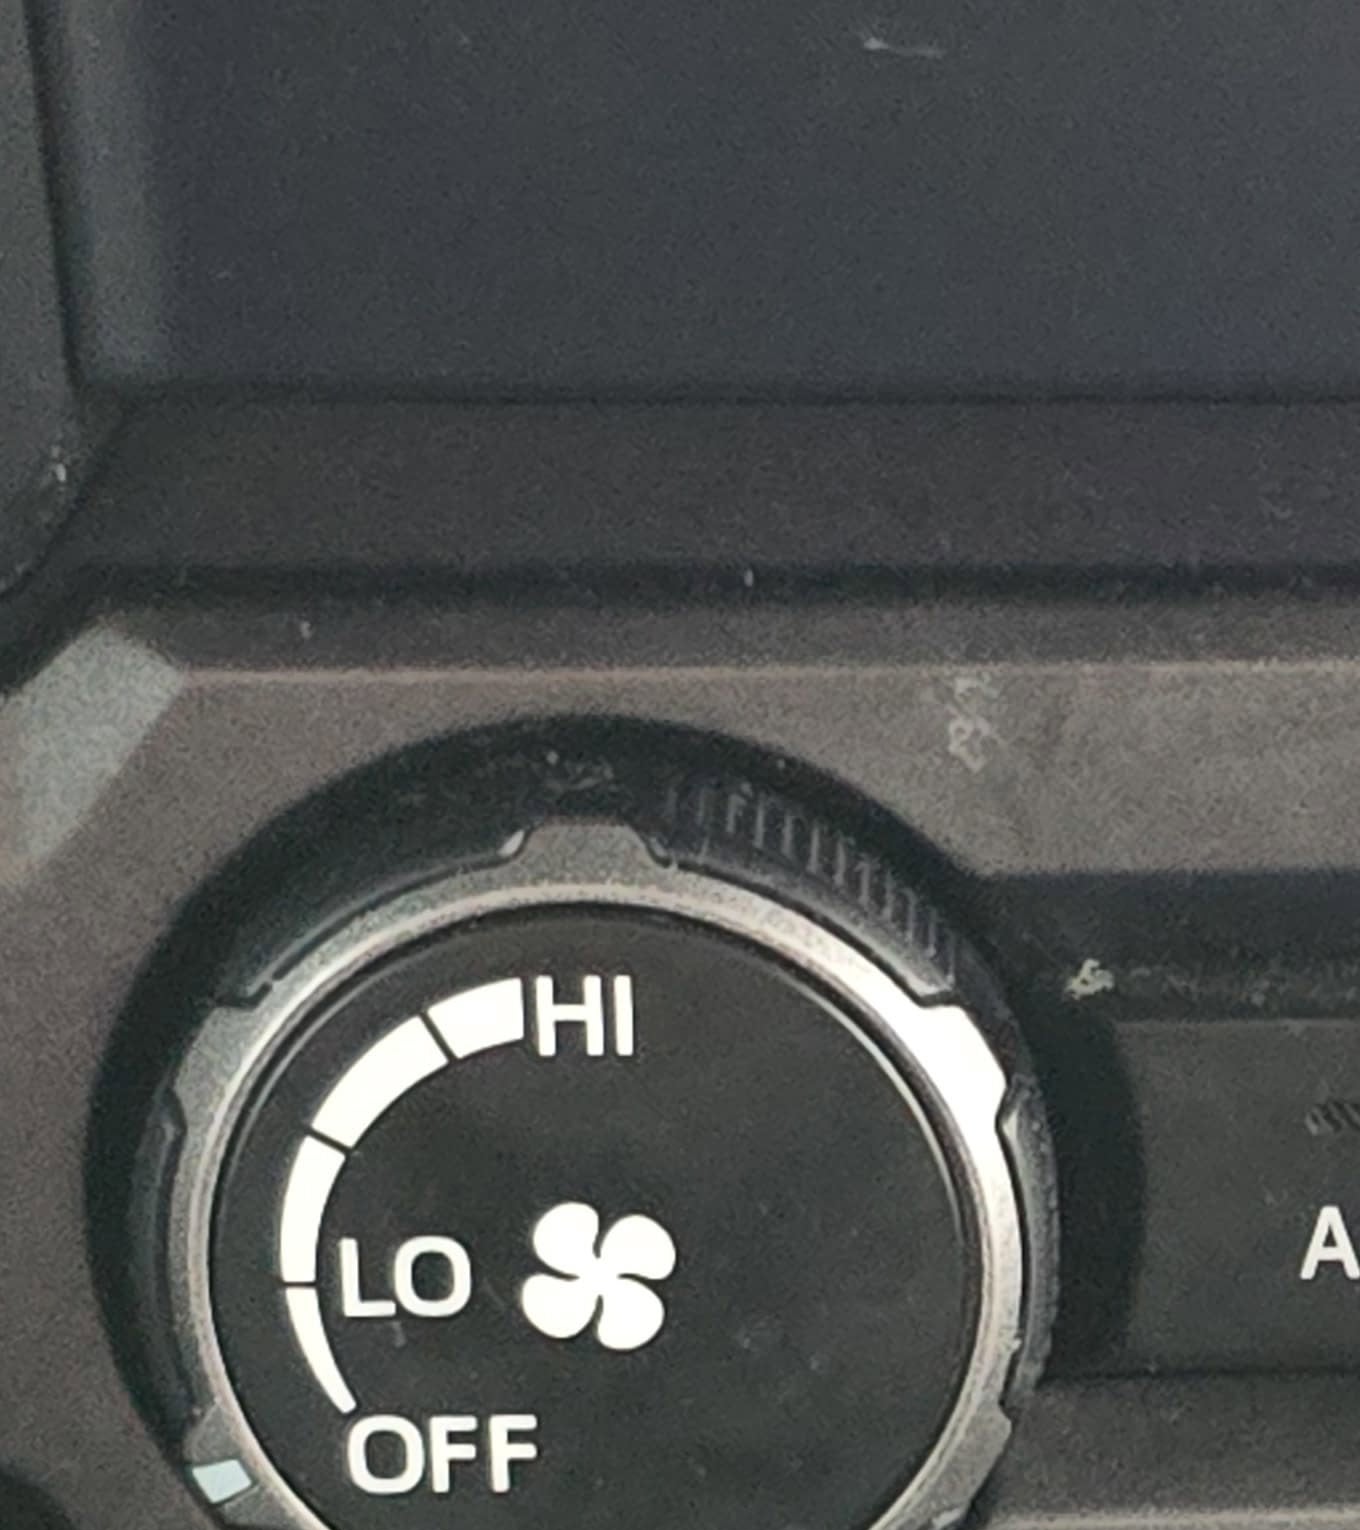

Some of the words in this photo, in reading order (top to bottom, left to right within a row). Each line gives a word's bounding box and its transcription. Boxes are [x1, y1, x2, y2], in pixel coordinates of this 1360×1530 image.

[533, 974, 635, 1057] HI
[338, 1235, 472, 1318] LO
[346, 1413, 538, 1495] OFF
